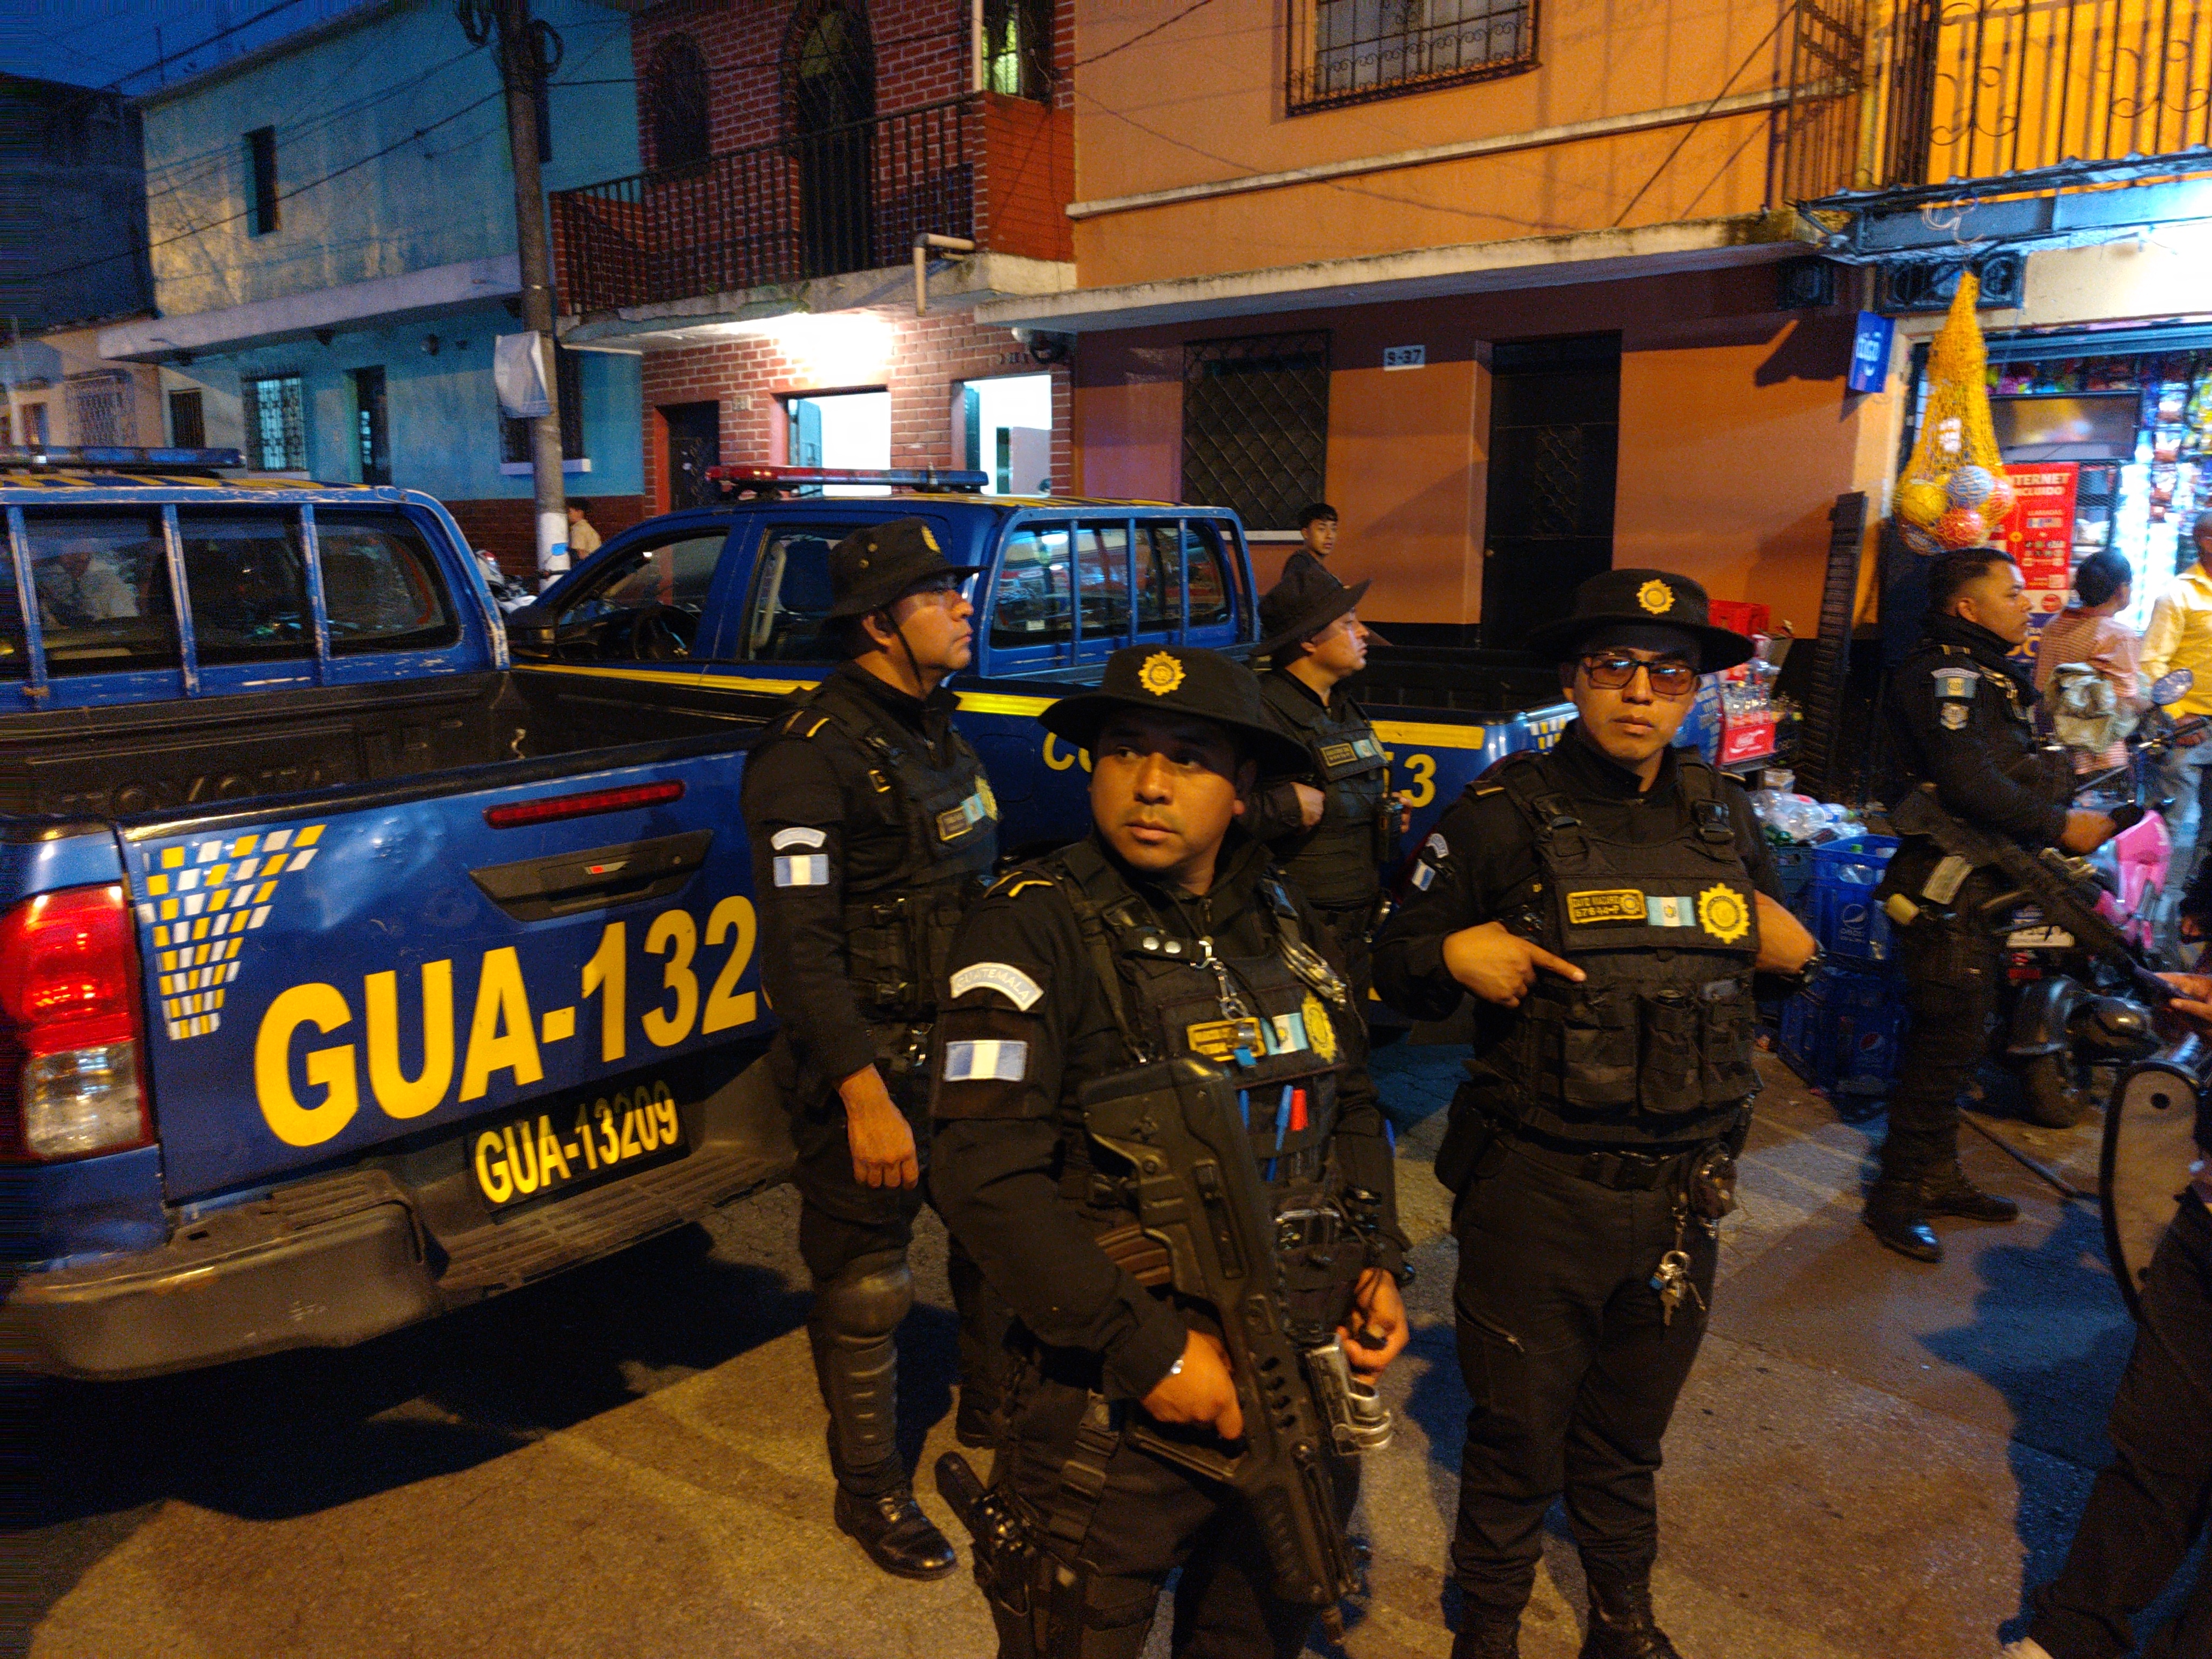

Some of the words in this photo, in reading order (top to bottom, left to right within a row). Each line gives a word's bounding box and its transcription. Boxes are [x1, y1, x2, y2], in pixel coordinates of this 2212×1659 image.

[254, 895, 773, 1148] GUA-132
[956, 969, 1030, 1000] GUATEMALA
[475, 1080, 679, 1203] GUA-13209
